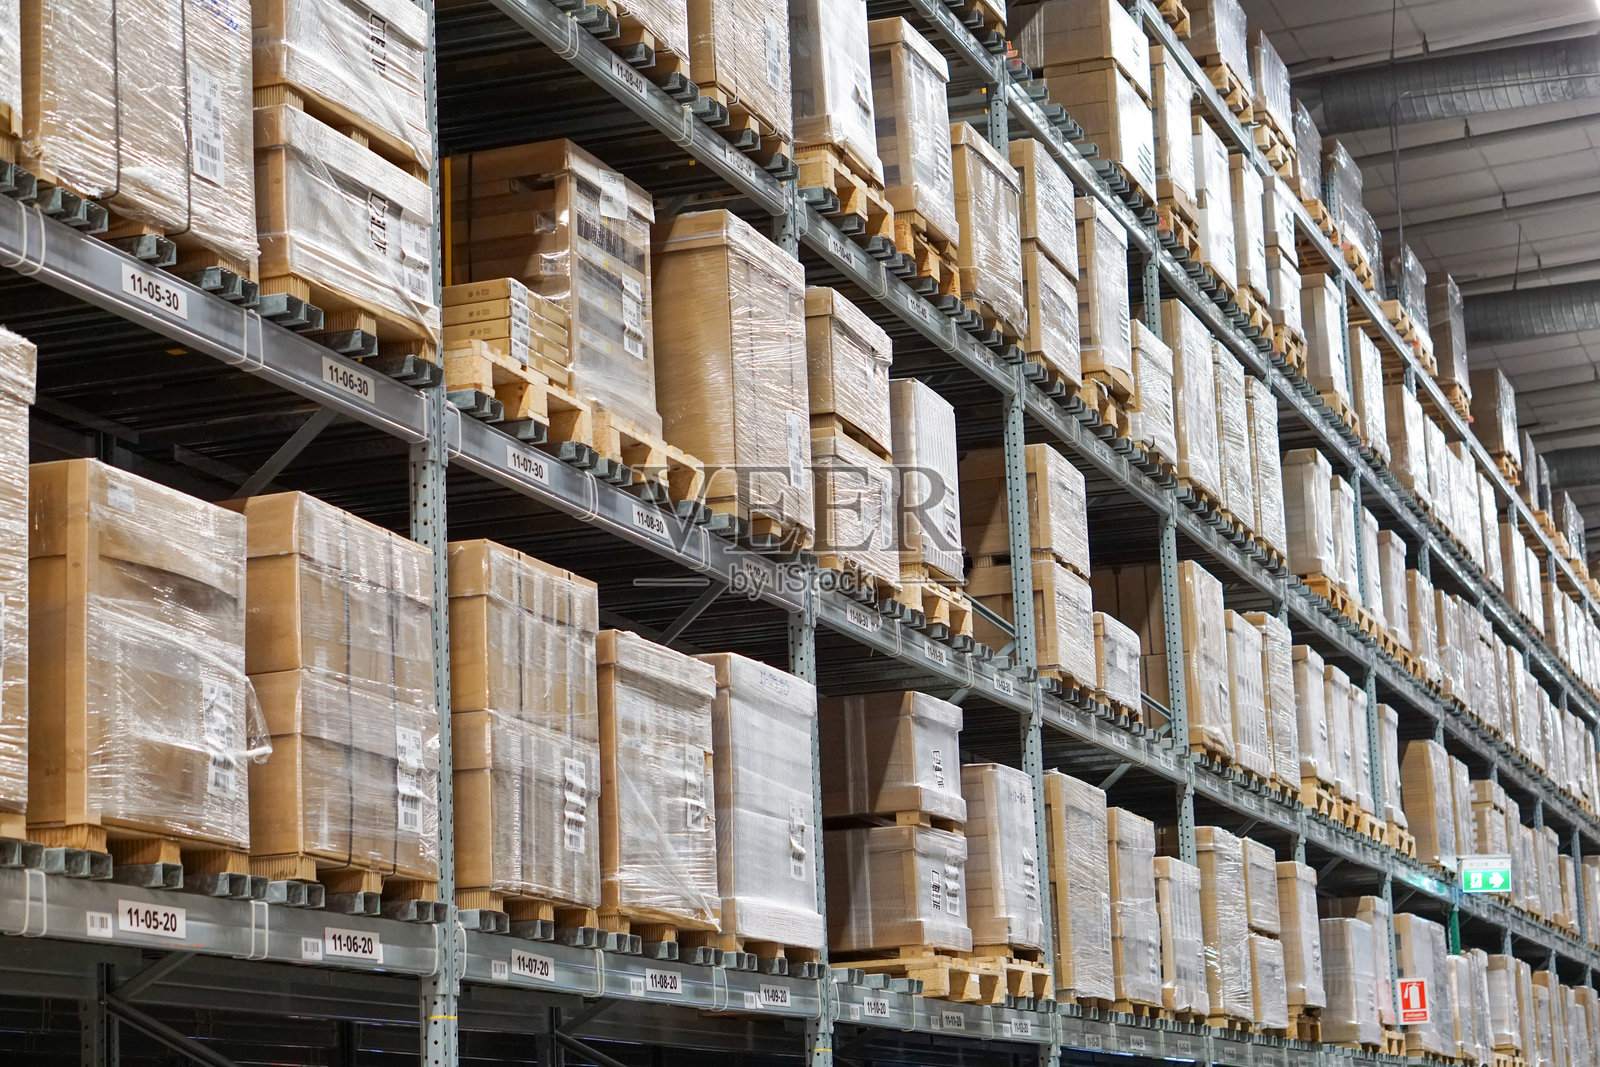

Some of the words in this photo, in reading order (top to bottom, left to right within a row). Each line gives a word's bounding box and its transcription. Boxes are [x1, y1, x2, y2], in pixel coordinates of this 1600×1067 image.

[130, 273, 179, 311] 11-05-30
[329, 365, 368, 396] 11-06-30
[512, 452, 543, 479] 11-07-30
[637, 510, 664, 534] 11-08-30
[127, 907, 177, 932] 11-05-20
[332, 933, 373, 955] 11-06-20
[517, 955, 549, 977] 11-07-20
[650, 973, 677, 990] 11-08-20
[763, 988, 787, 1003] 11-09-20
